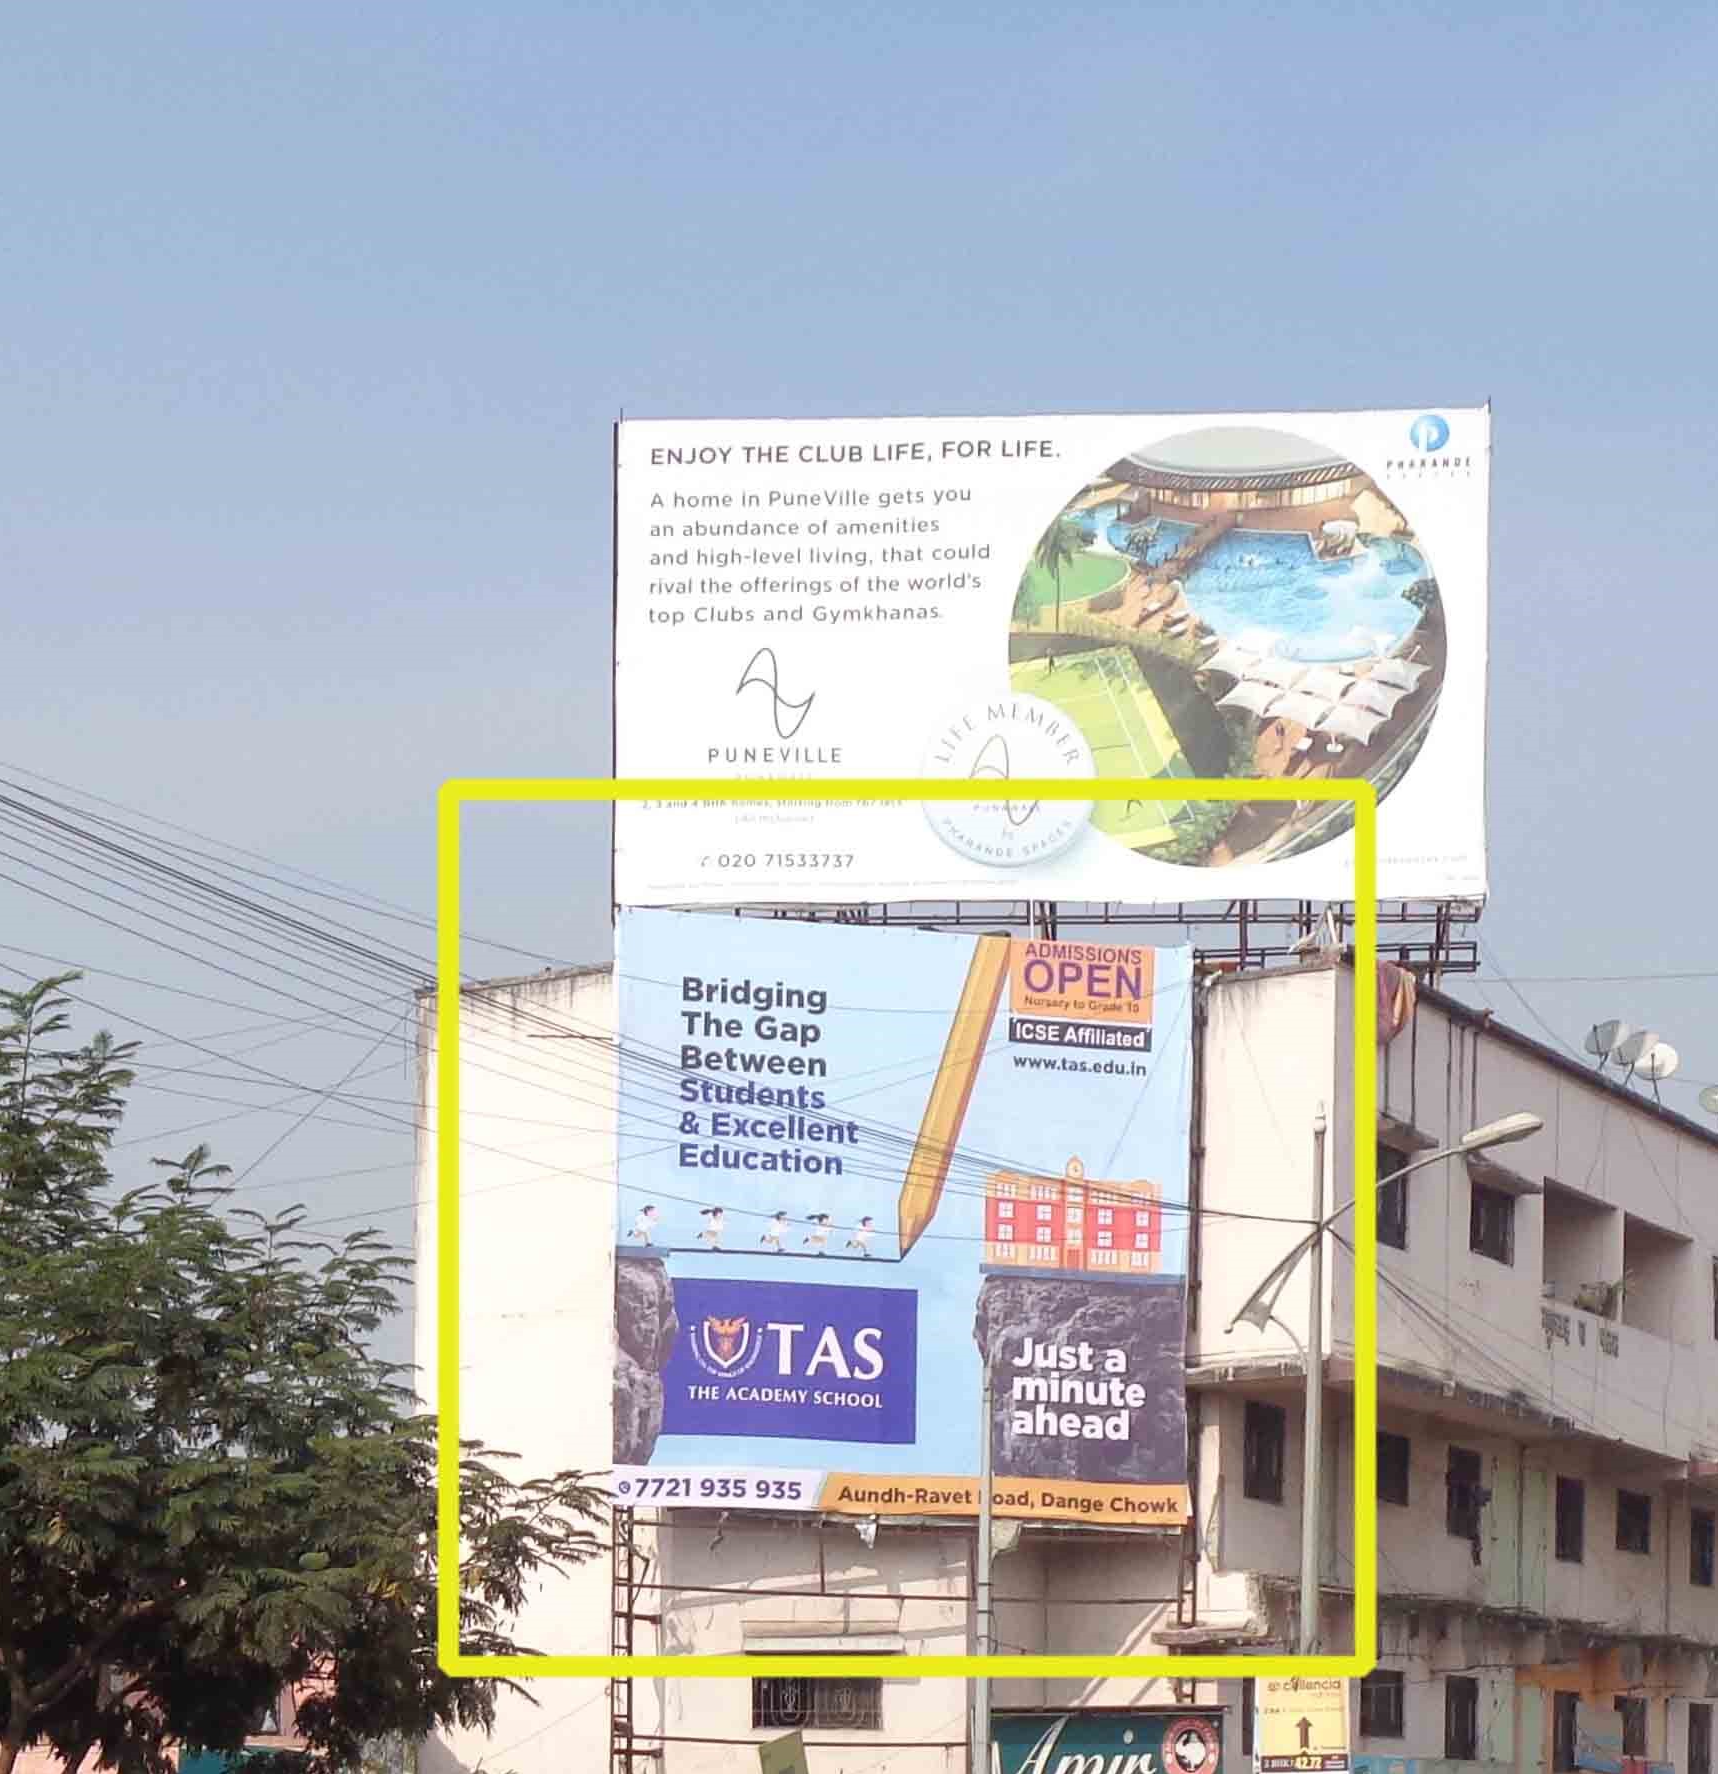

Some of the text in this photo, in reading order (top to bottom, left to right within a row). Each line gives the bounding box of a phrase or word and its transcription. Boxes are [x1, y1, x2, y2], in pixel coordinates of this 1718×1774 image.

[651, 440, 1061, 465] ENJOY THE CLUB LIFE, FOR LIFE.
[650, 486, 973, 508] A home in PuneVille gets you
[650, 517, 940, 537] an abundance of amenities
[650, 544, 991, 568] and high-level living, that could
[650, 572, 982, 597] rival the offerings of the world's
[649, 603, 944, 627] top Clubs and Gymkhanas.
[934, 702, 1081, 766] LIFE MEMBER
[708, 746, 843, 764] PUNEVILLE
[718, 854, 855, 868] 020 71533737
[1025, 943, 1142, 963] ADMISSIONS
[1023, 959, 1142, 1001] OPEN
[682, 976, 827, 1015] Bridging
[1089, 1001, 1123, 1013] Grade
[681, 1011, 821, 1048] The Gap
[1016, 1022, 1145, 1048] ICSE Affiliated
[681, 1044, 827, 1077] Between
[1013, 1056, 1146, 1077] www.tas.edu.in
[680, 1078, 826, 1110] Students
[679, 1111, 859, 1144] & Excellent
[679, 1143, 843, 1176] Education
[767, 1322, 883, 1380] TAS
[1012, 1337, 1127, 1373] Just a
[688, 1385, 884, 1409] THE ACADEMY SCHOOL
[1012, 1371, 1146, 1408] minute
[1011, 1403, 1130, 1441] ahead
[635, 1478, 802, 1500] 7721 935 935
[838, 1485, 1179, 1517] Aundh-Ravet oad, Dange Chowk
